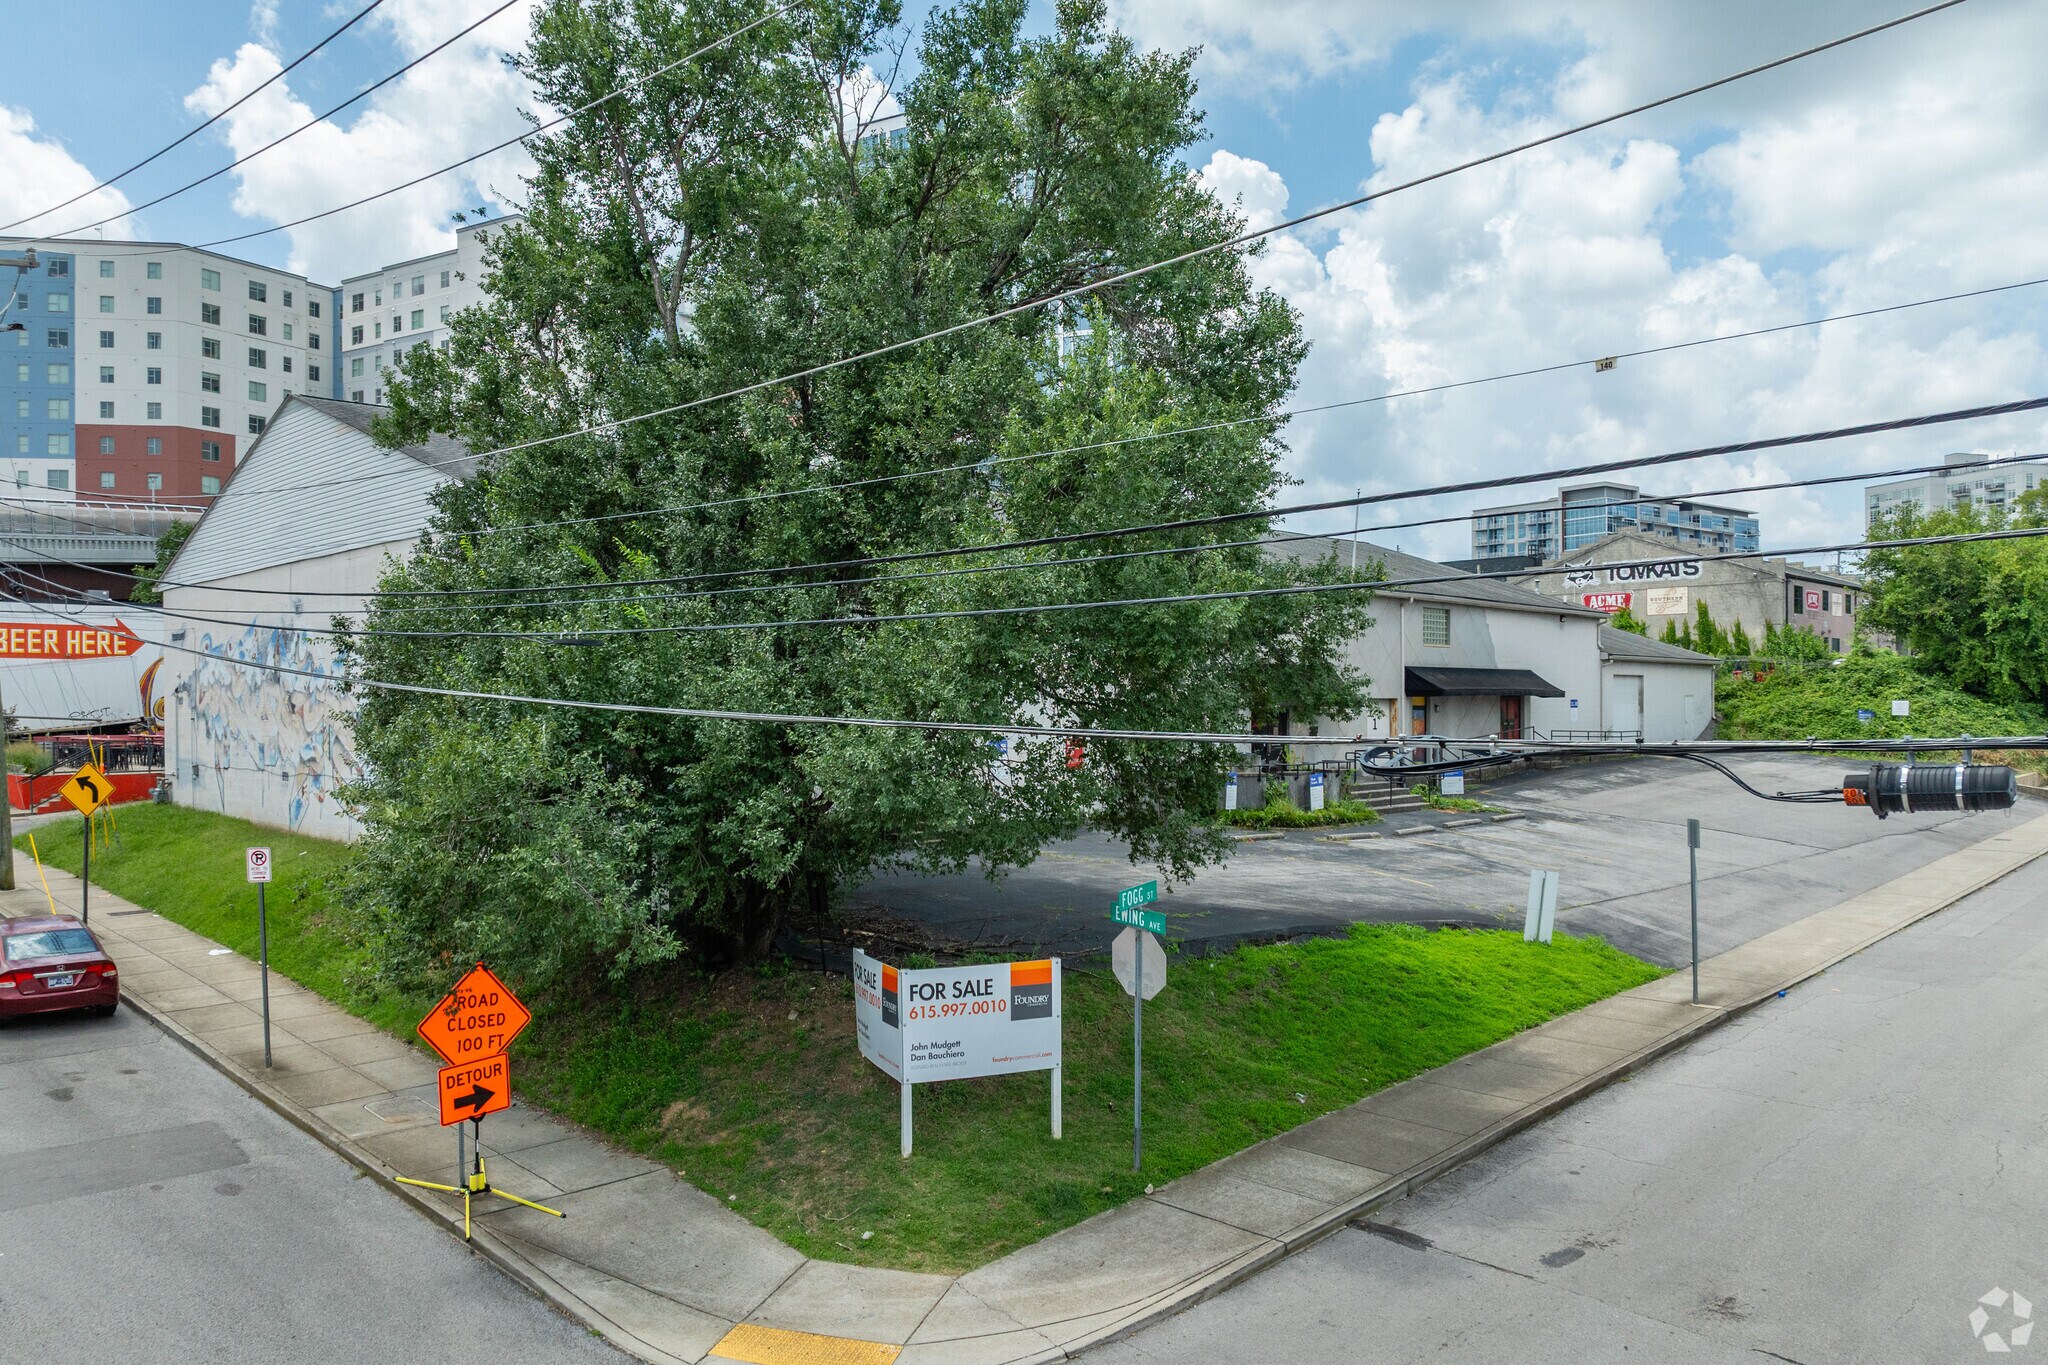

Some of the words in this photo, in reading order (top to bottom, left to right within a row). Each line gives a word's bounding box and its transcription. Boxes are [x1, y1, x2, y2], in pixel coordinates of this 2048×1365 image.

[1608, 561, 1700, 581] TOMKATS
[1589, 594, 1626, 609] ACME
[0, 628, 60, 654] BEER
[67, 630, 127, 655] HERE
[1845, 789, 1862, 797] 208
[1121, 887, 1144, 908] FOGG
[1147, 890, 1154, 900] ST
[1115, 905, 1145, 927] EWING
[1149, 920, 1161, 931] AVE
[864, 969, 877, 990] SALE
[910, 982, 947, 1002] FOR
[952, 978, 993, 999] SALE
[457, 992, 499, 1009] ROAD
[909, 998, 1007, 1020] 615.997.0010
[447, 1012, 506, 1032] CLOSED
[457, 1037, 483, 1053] 100
[488, 1034, 504, 1049] FT
[910, 1041, 928, 1052] John
[930, 1040, 961, 1050] Mudgett
[910, 1053, 926, 1062] Dan
[928, 1050, 965, 1060] Bauchiero
[992, 1052, 1053, 1063] foundrycommercial.com
[446, 1063, 503, 1090] DETOUR
